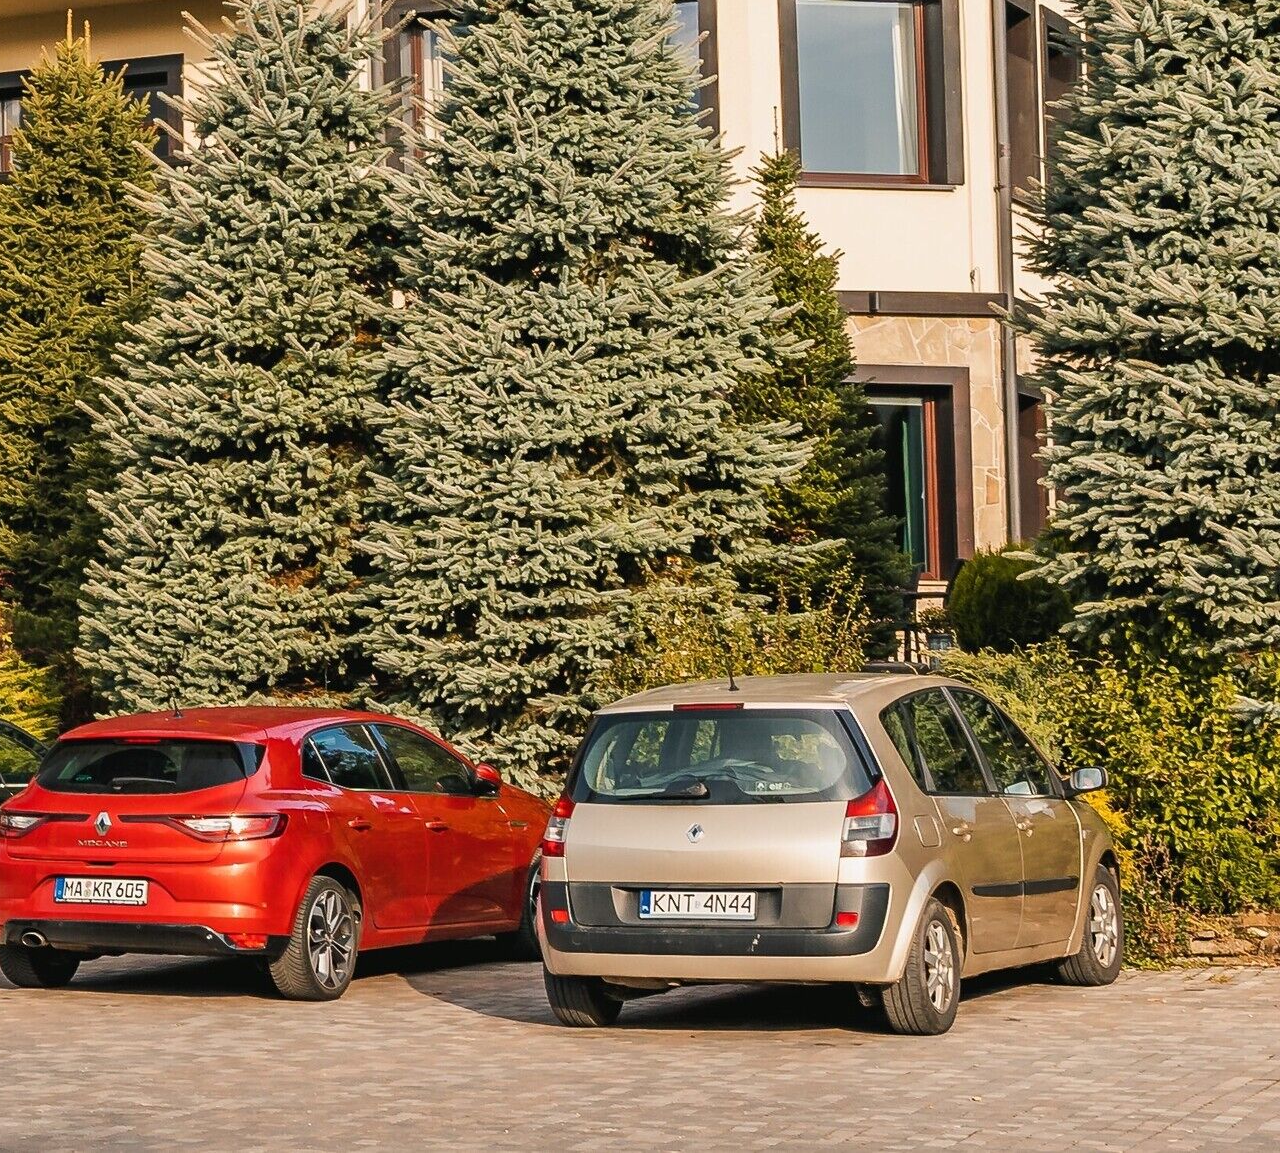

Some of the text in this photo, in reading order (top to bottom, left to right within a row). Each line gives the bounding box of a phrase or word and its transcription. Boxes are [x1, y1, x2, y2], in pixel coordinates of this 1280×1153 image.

[64, 880, 145, 899] MA KR 605
[653, 894, 752, 914] KNT 4N44
